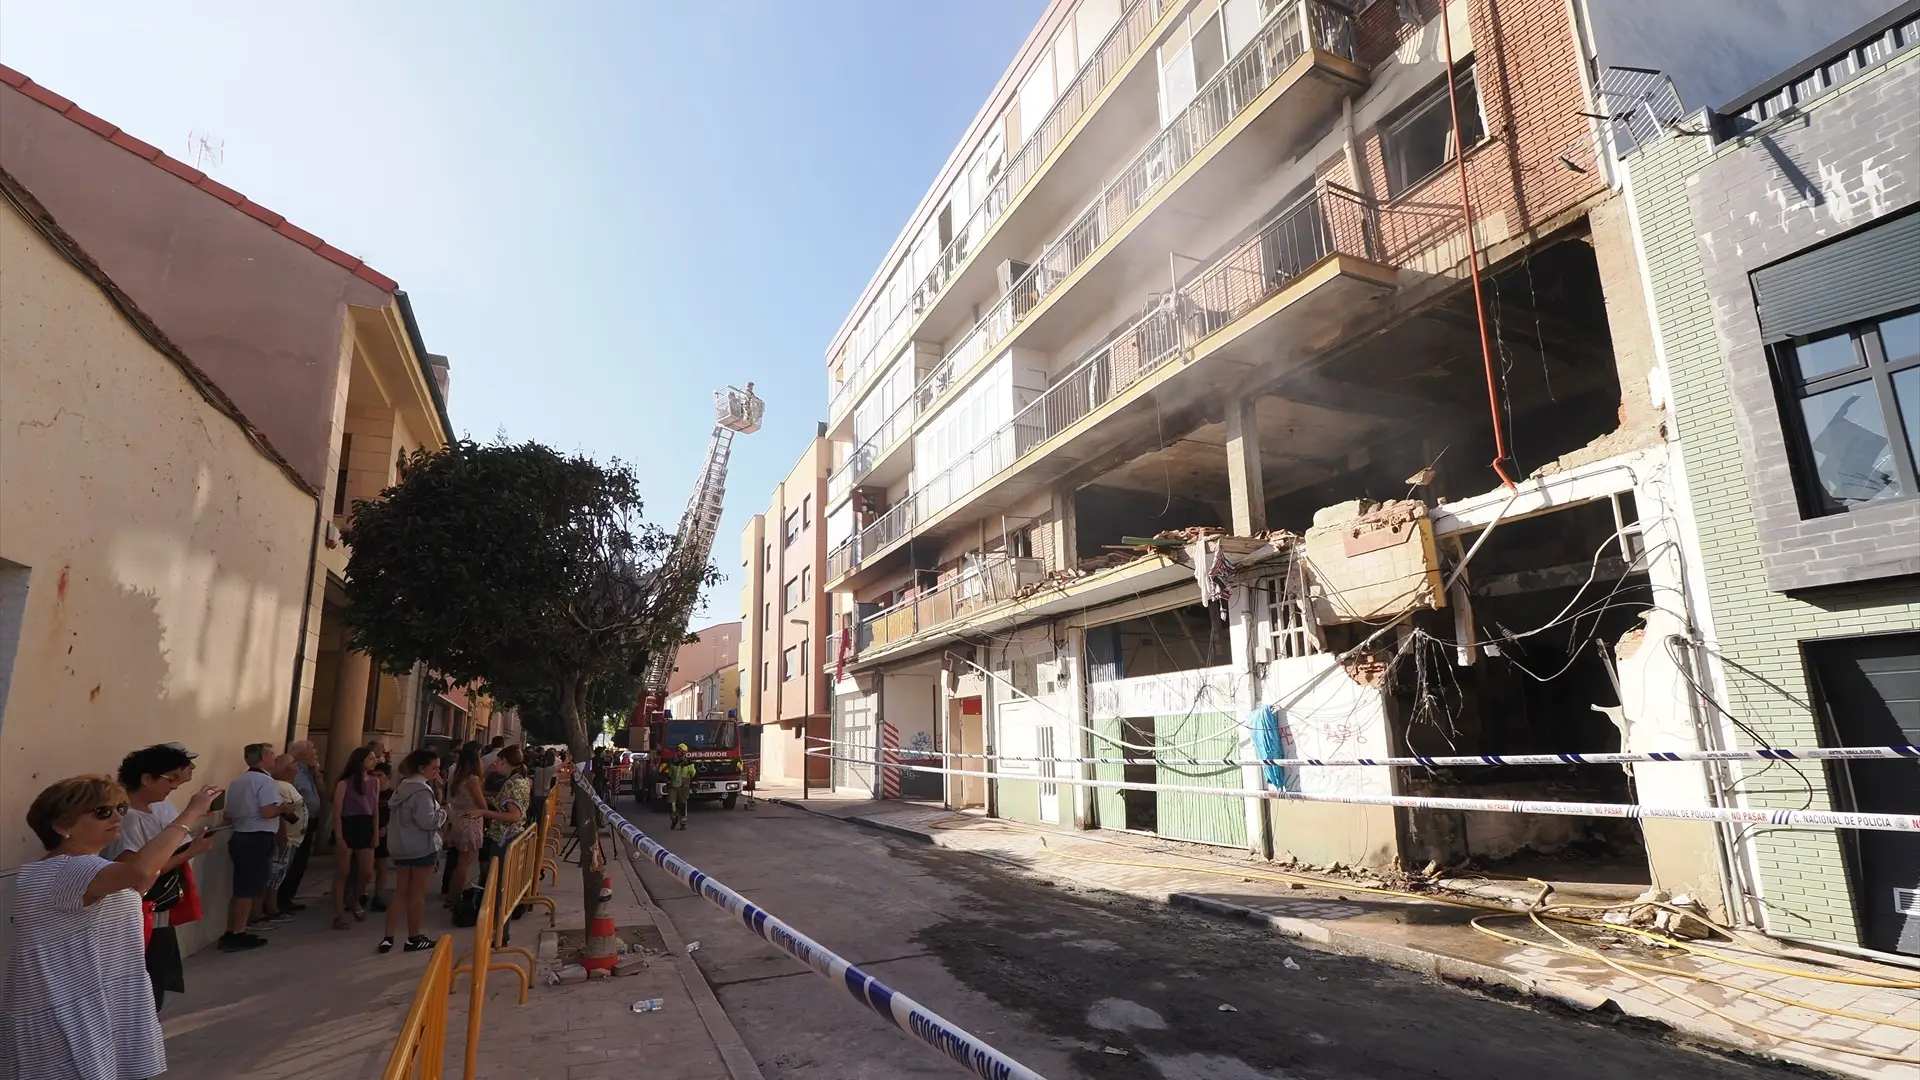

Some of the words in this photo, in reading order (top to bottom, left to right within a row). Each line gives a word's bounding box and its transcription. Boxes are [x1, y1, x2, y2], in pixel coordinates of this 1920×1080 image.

[1595, 806, 1603, 814] NO
[1604, 806, 1623, 815] PASAR
[1650, 808, 1680, 818] NACIONAL
[1681, 810, 1689, 818] DE
[1691, 810, 1717, 819] POLICIA
[1731, 811, 1742, 820] NO
[1743, 811, 1768, 821] PASAR
[1803, 814, 1843, 825] NACIONAL
[1844, 816, 1855, 826] DE
[1857, 816, 1892, 827] POLICIA
